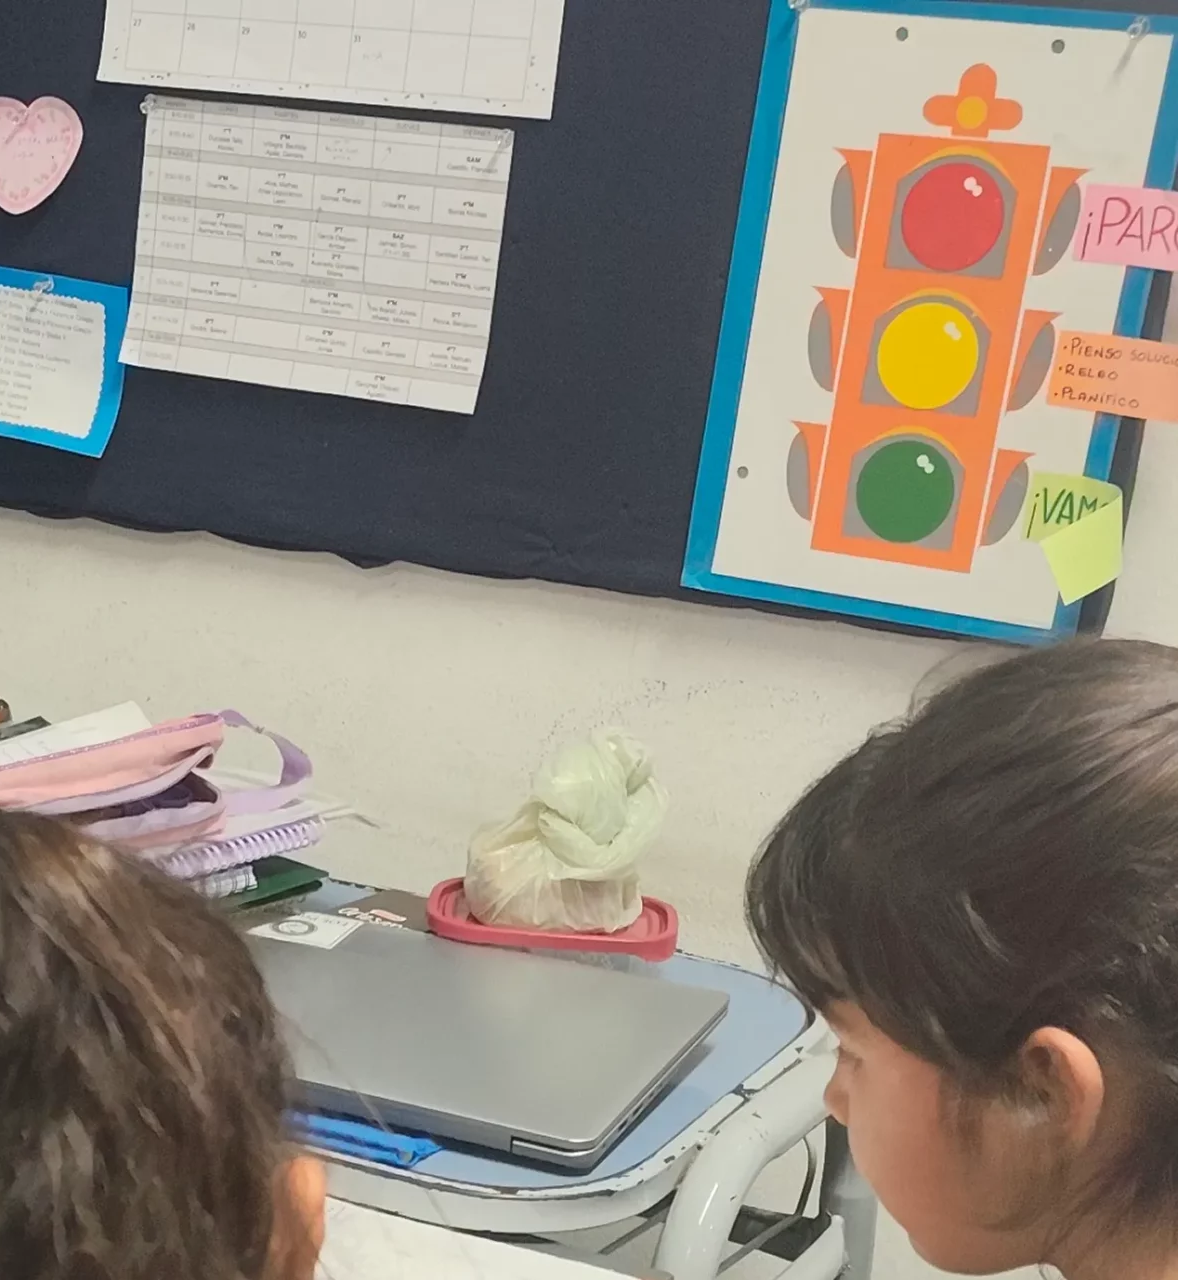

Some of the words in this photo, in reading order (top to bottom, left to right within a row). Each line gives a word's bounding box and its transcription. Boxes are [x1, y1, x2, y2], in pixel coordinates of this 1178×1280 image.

[240, 26, 250, 36] 29
[1080, 196, 1178, 261] ¡PAR
[1070, 337, 1123, 360] PIENSO
[1026, 487, 1109, 539] ¡VAM
